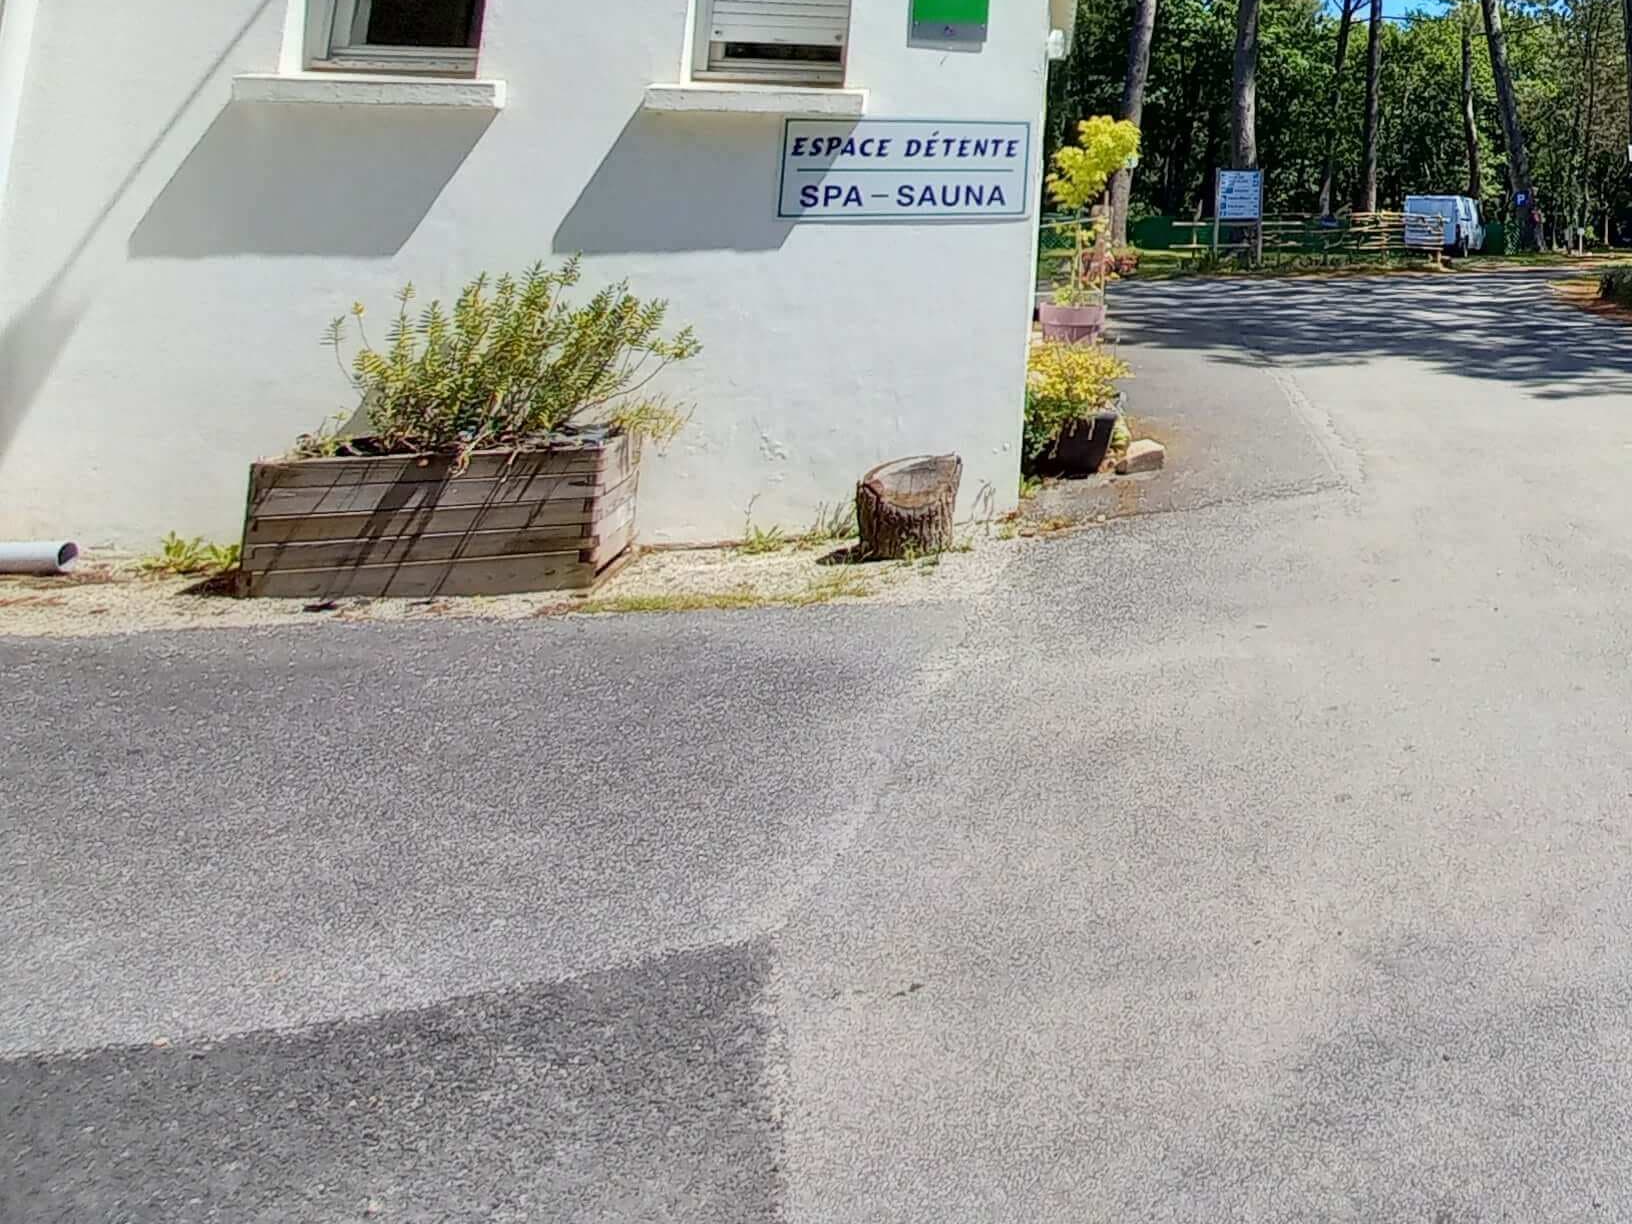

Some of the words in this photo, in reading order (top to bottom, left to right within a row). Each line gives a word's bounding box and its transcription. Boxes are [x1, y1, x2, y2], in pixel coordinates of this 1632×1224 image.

[791, 136, 892, 158] ESPACE
[904, 130, 1020, 158] DÉTENTE
[800, 184, 863, 208] SPA
[896, 184, 1007, 207] SAUNA
[1517, 194, 1526, 205] P
